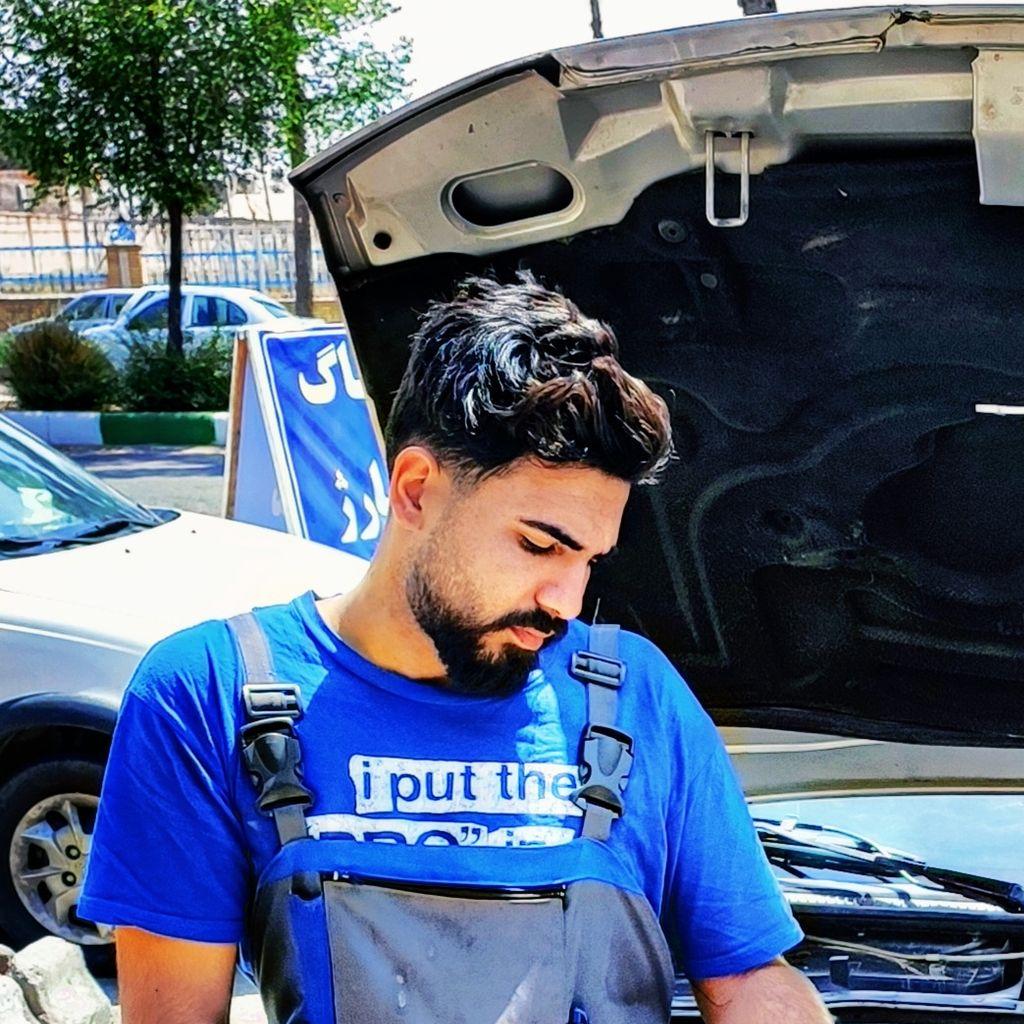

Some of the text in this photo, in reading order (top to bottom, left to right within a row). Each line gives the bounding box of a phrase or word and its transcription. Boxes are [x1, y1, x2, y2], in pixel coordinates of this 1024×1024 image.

[298, 340, 367, 405] اگ
[334, 458, 390, 544] ارژ
[362, 761, 578, 813] i put the
